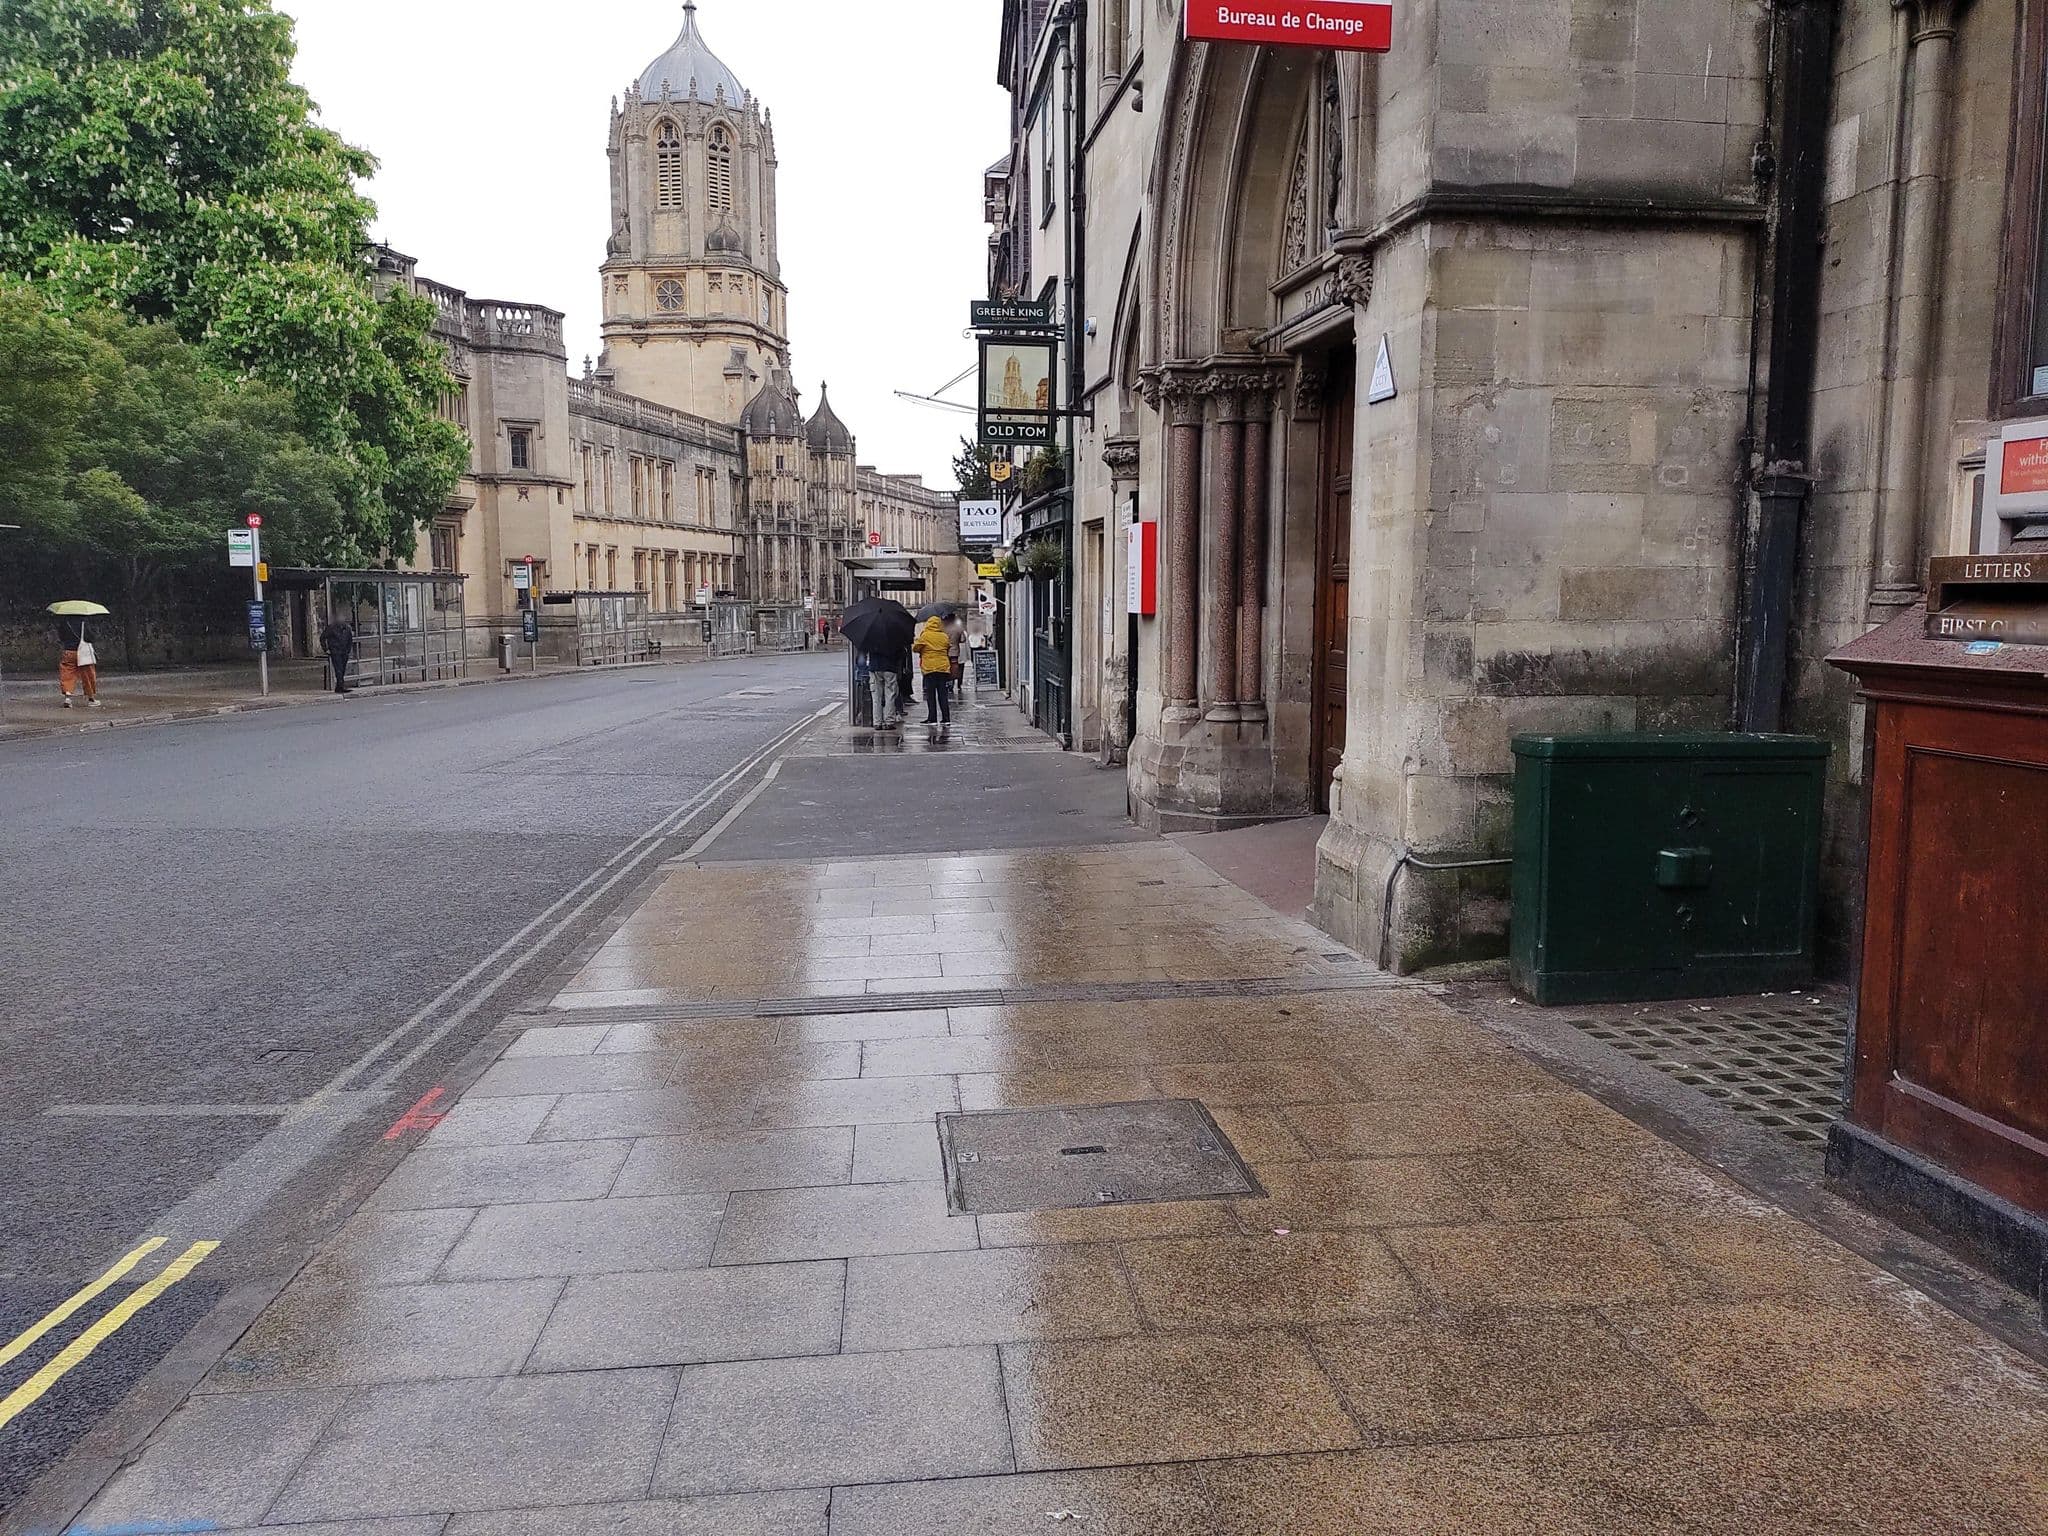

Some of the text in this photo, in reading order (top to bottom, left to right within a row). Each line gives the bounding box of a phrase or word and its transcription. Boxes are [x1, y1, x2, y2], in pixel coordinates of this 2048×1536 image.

[1218, 6, 1364, 35] Bureau de Change
[976, 307, 1044, 317] GREENE KING
[987, 425, 1046, 438] OLD TOM
[963, 507, 997, 516] TAO
[249, 516, 261, 525] H2
[869, 535, 880, 543] G3
[1965, 562, 2032, 578] LETTERS
[1940, 618, 1987, 634] FIRST
